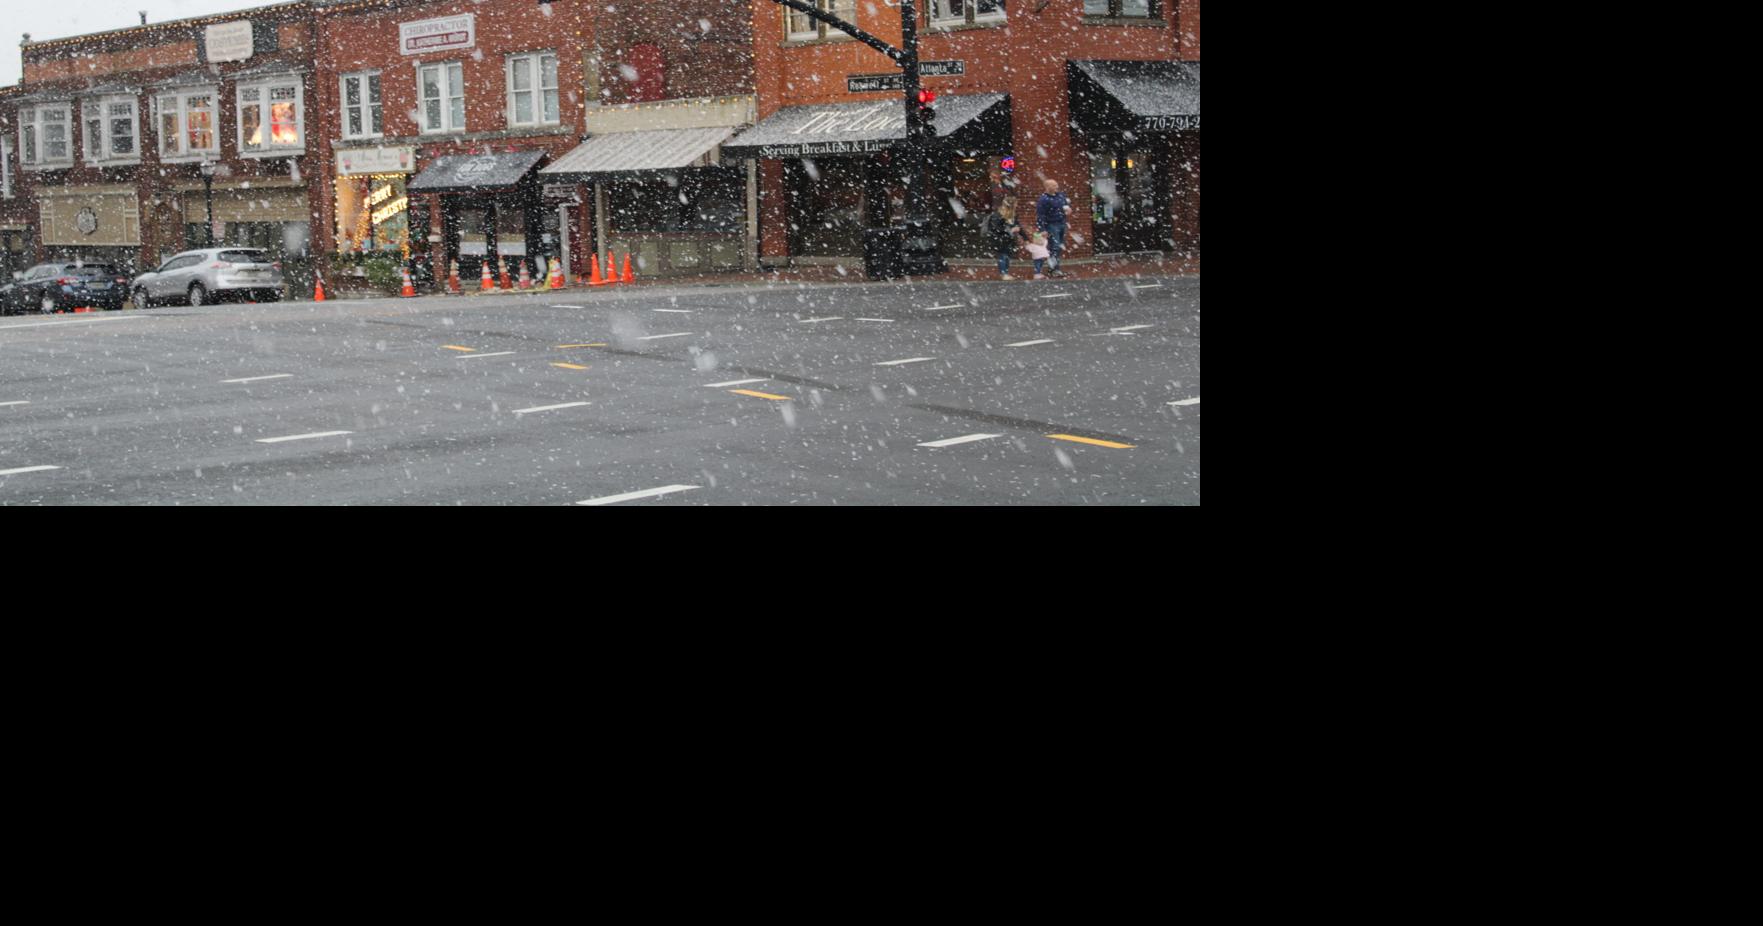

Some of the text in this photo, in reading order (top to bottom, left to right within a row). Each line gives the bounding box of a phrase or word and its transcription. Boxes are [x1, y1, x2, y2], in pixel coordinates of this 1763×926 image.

[404, 18, 469, 37] CHIROPRACTOR
[920, 63, 947, 74] Atlanta
[791, 110, 850, 134] The
[762, 145, 800, 157] Serving
[801, 140, 850, 154] Breakfast
[853, 140, 864, 152] &
